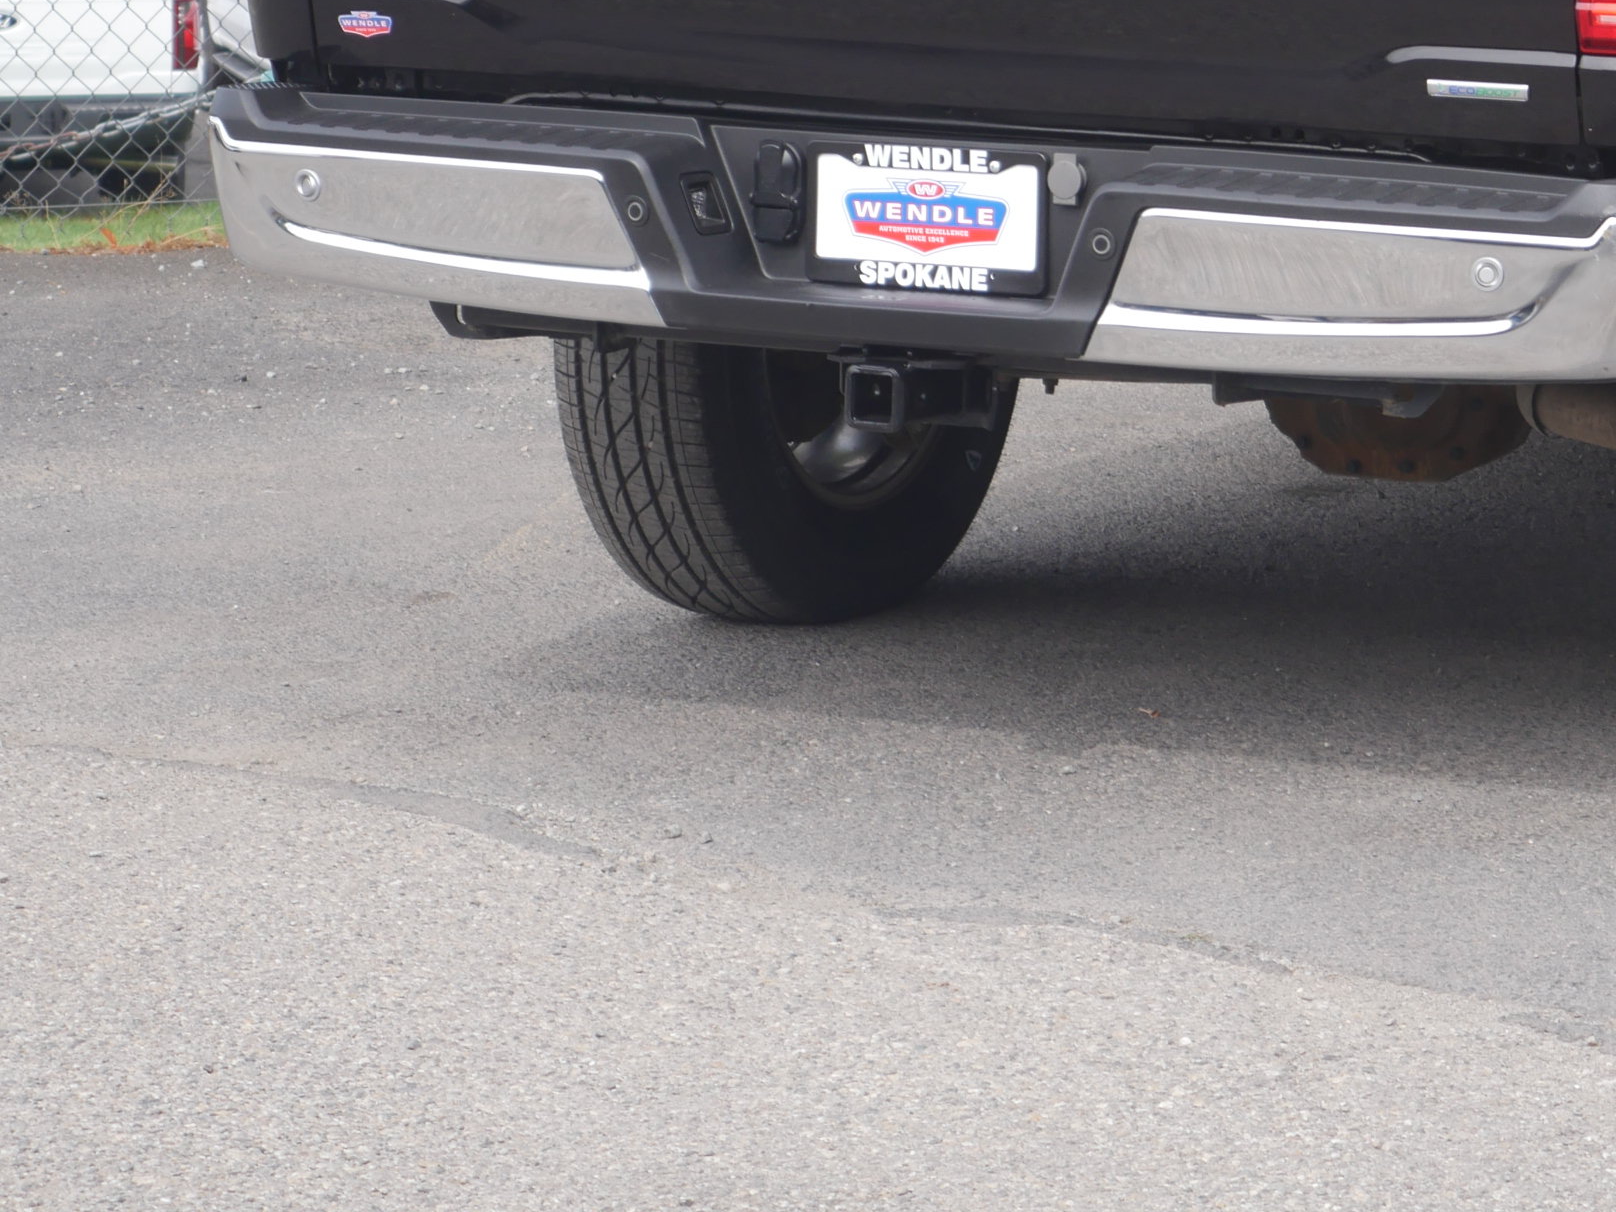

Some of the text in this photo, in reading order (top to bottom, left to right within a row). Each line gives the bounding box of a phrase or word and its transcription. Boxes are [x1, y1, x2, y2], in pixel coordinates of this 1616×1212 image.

[341, 18, 388, 28] WENDLE
[863, 143, 989, 173] WENDLE
[853, 200, 994, 225] WENDLE
[879, 224, 970, 237] AUTOMOTIVE EXCELLENCE
[905, 234, 927, 242] SINCE
[858, 259, 989, 292] SPOKANE
